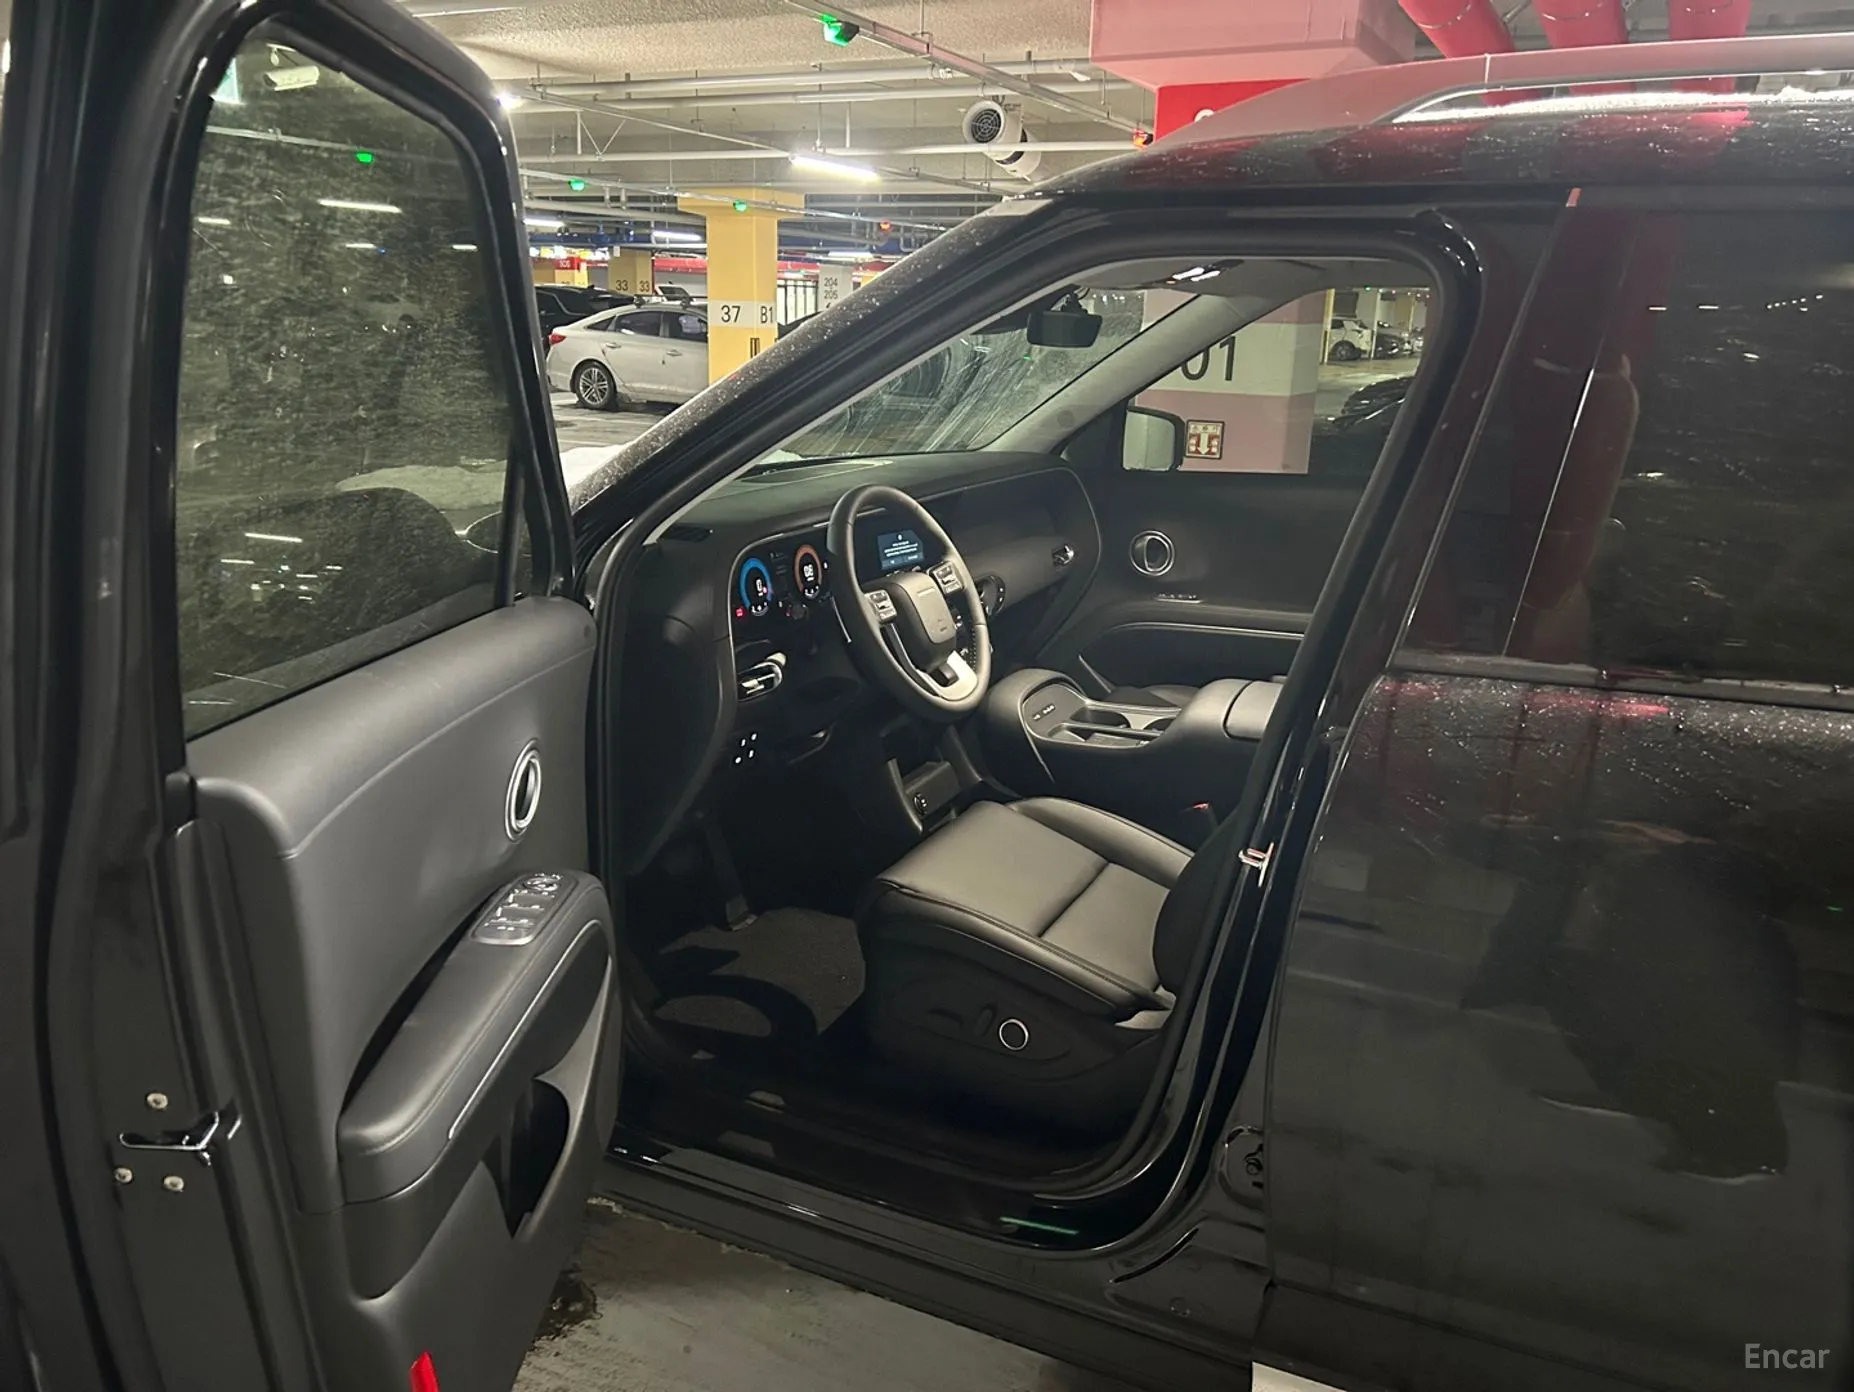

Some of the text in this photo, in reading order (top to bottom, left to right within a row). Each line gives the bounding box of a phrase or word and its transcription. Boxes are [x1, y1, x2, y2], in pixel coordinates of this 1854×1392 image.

[615, 280, 629, 292] 33
[639, 281, 650, 292] 33
[824, 277, 838, 288] 204
[721, 305, 741, 324] 37
[760, 306, 773, 324] B1
